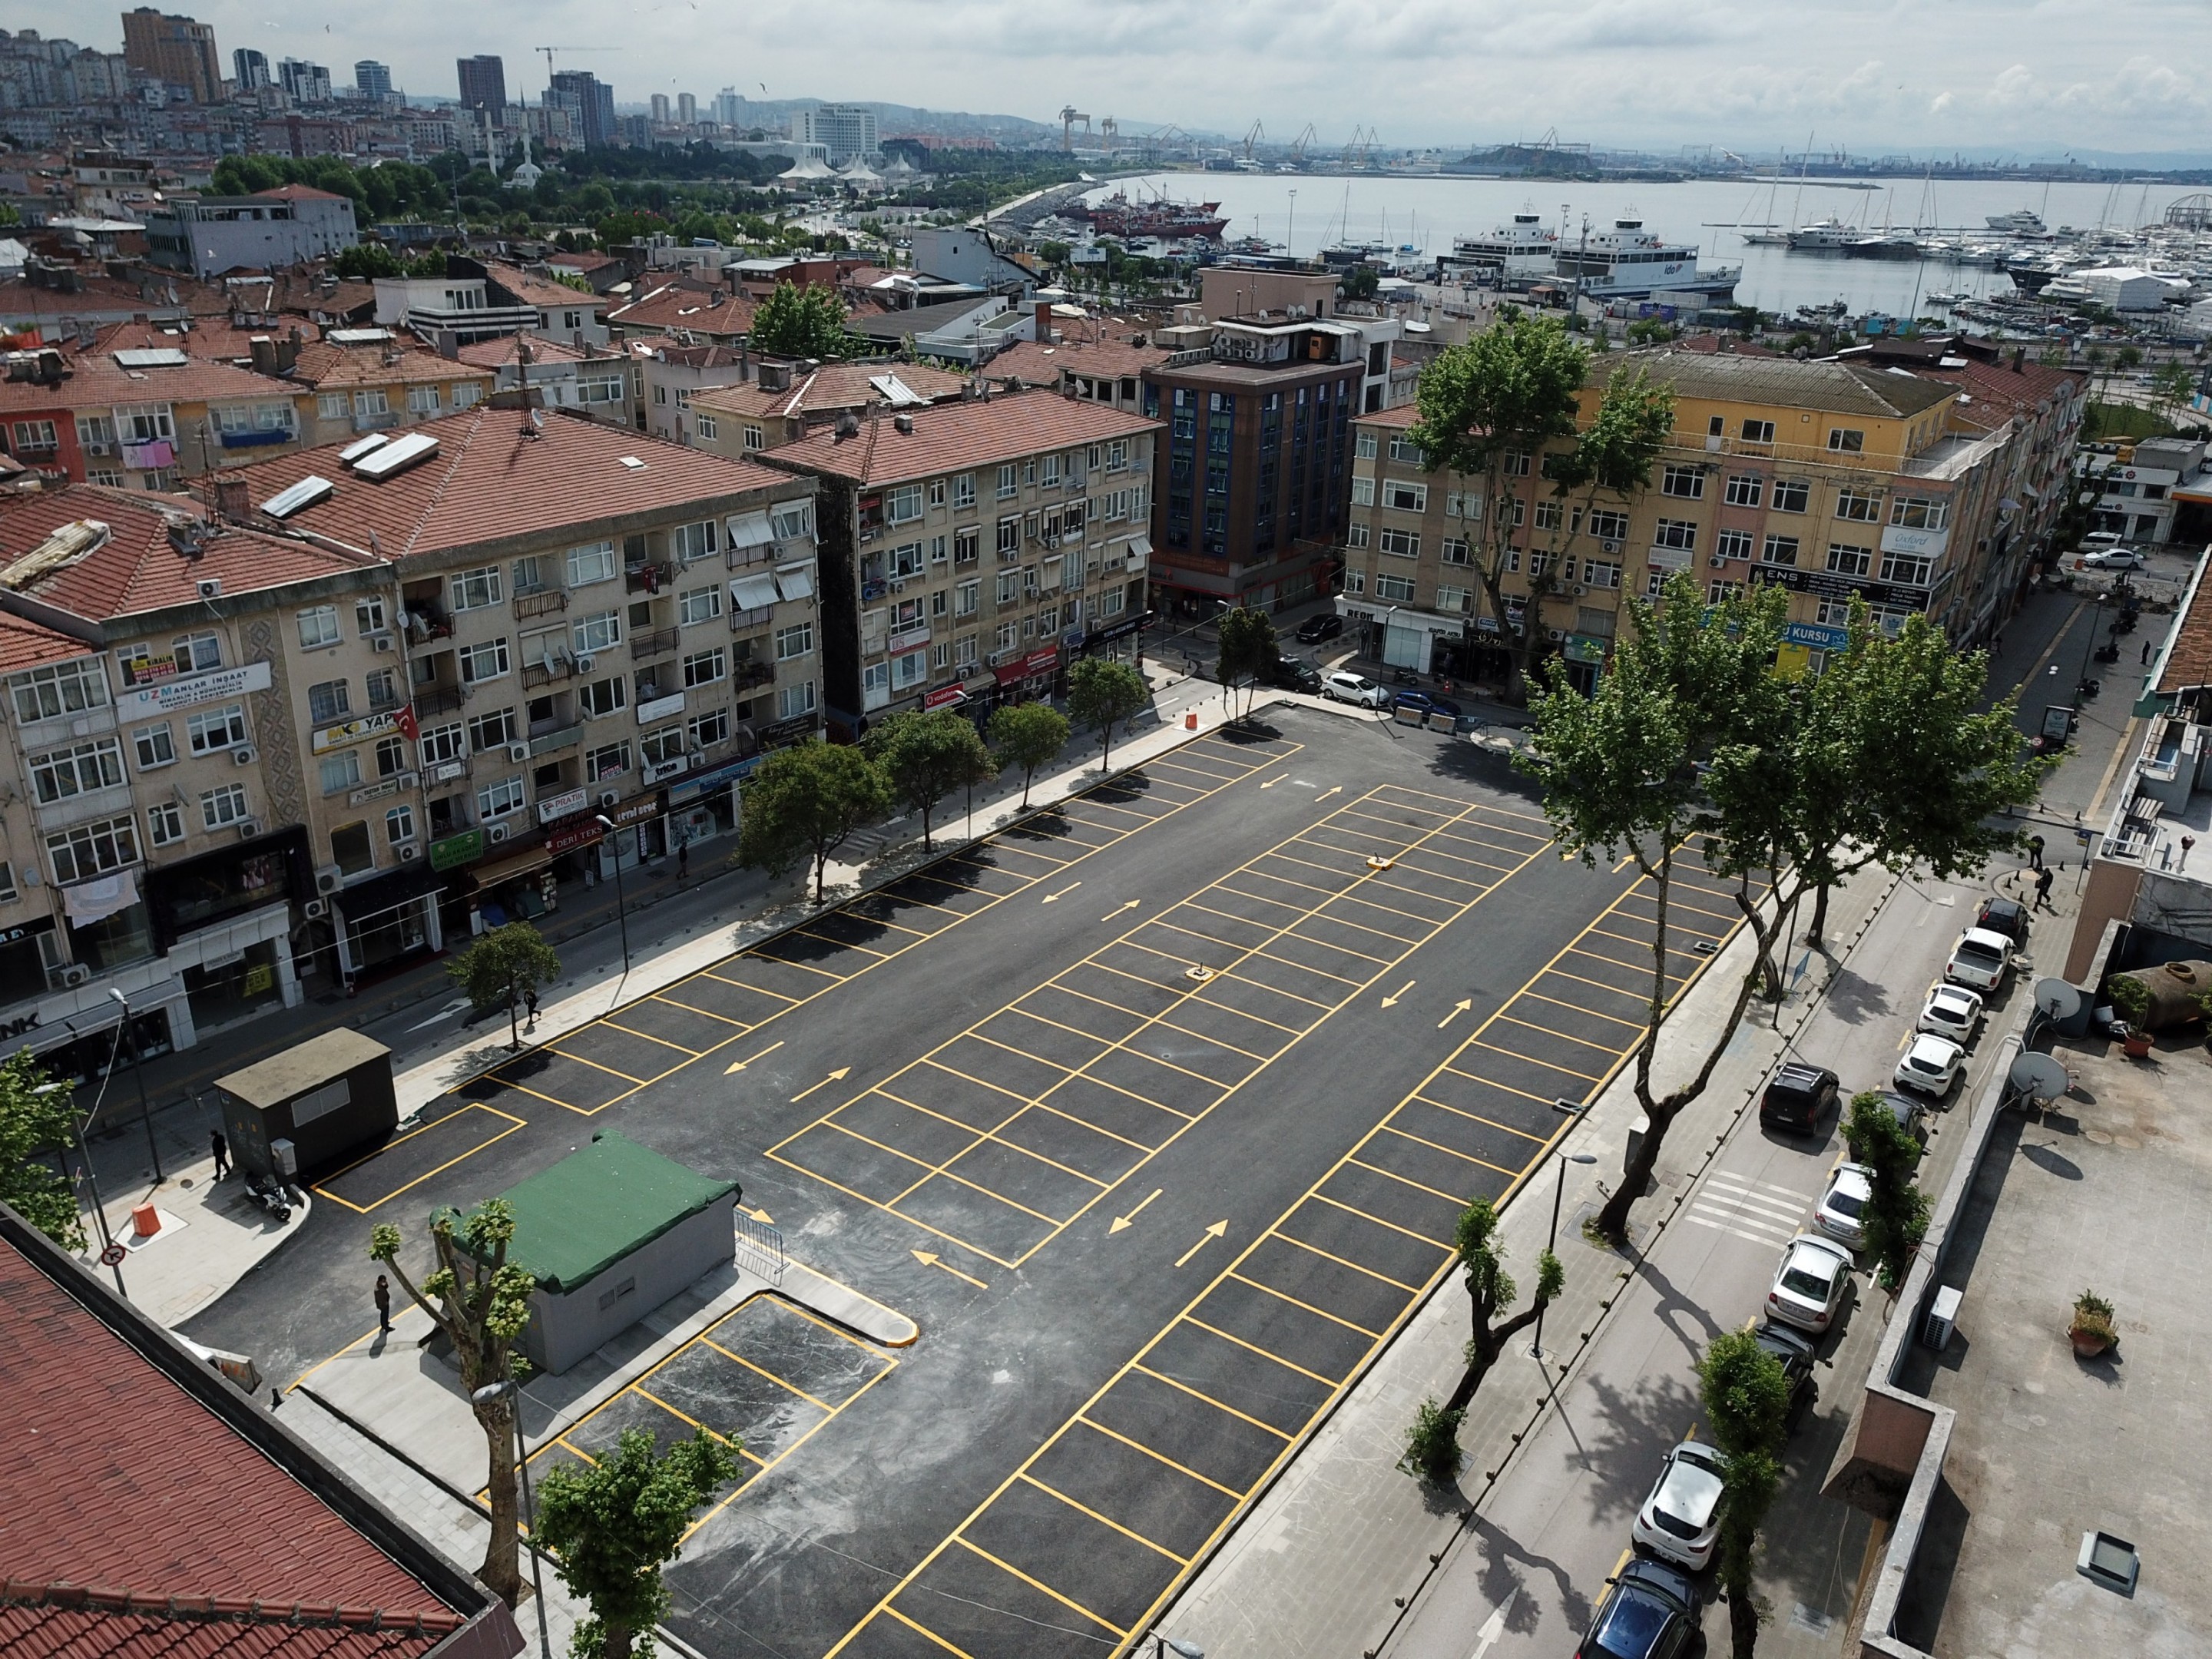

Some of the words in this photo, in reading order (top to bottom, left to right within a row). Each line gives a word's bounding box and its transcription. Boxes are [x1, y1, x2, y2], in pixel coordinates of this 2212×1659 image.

[1664, 264, 1675, 275] ido
[1895, 534, 1929, 545] Oxford
[1214, 545, 1224, 553] 83
[1767, 570, 1798, 581] ENS
[1792, 628, 1830, 643] KURSU
[139, 680, 207, 703] UZMANLAR
[212, 671, 248, 686] İNŞAAT
[555, 792, 584, 807] PRATİK
[556, 833, 578, 848] DERİ
[580, 826, 603, 839] TEKS
